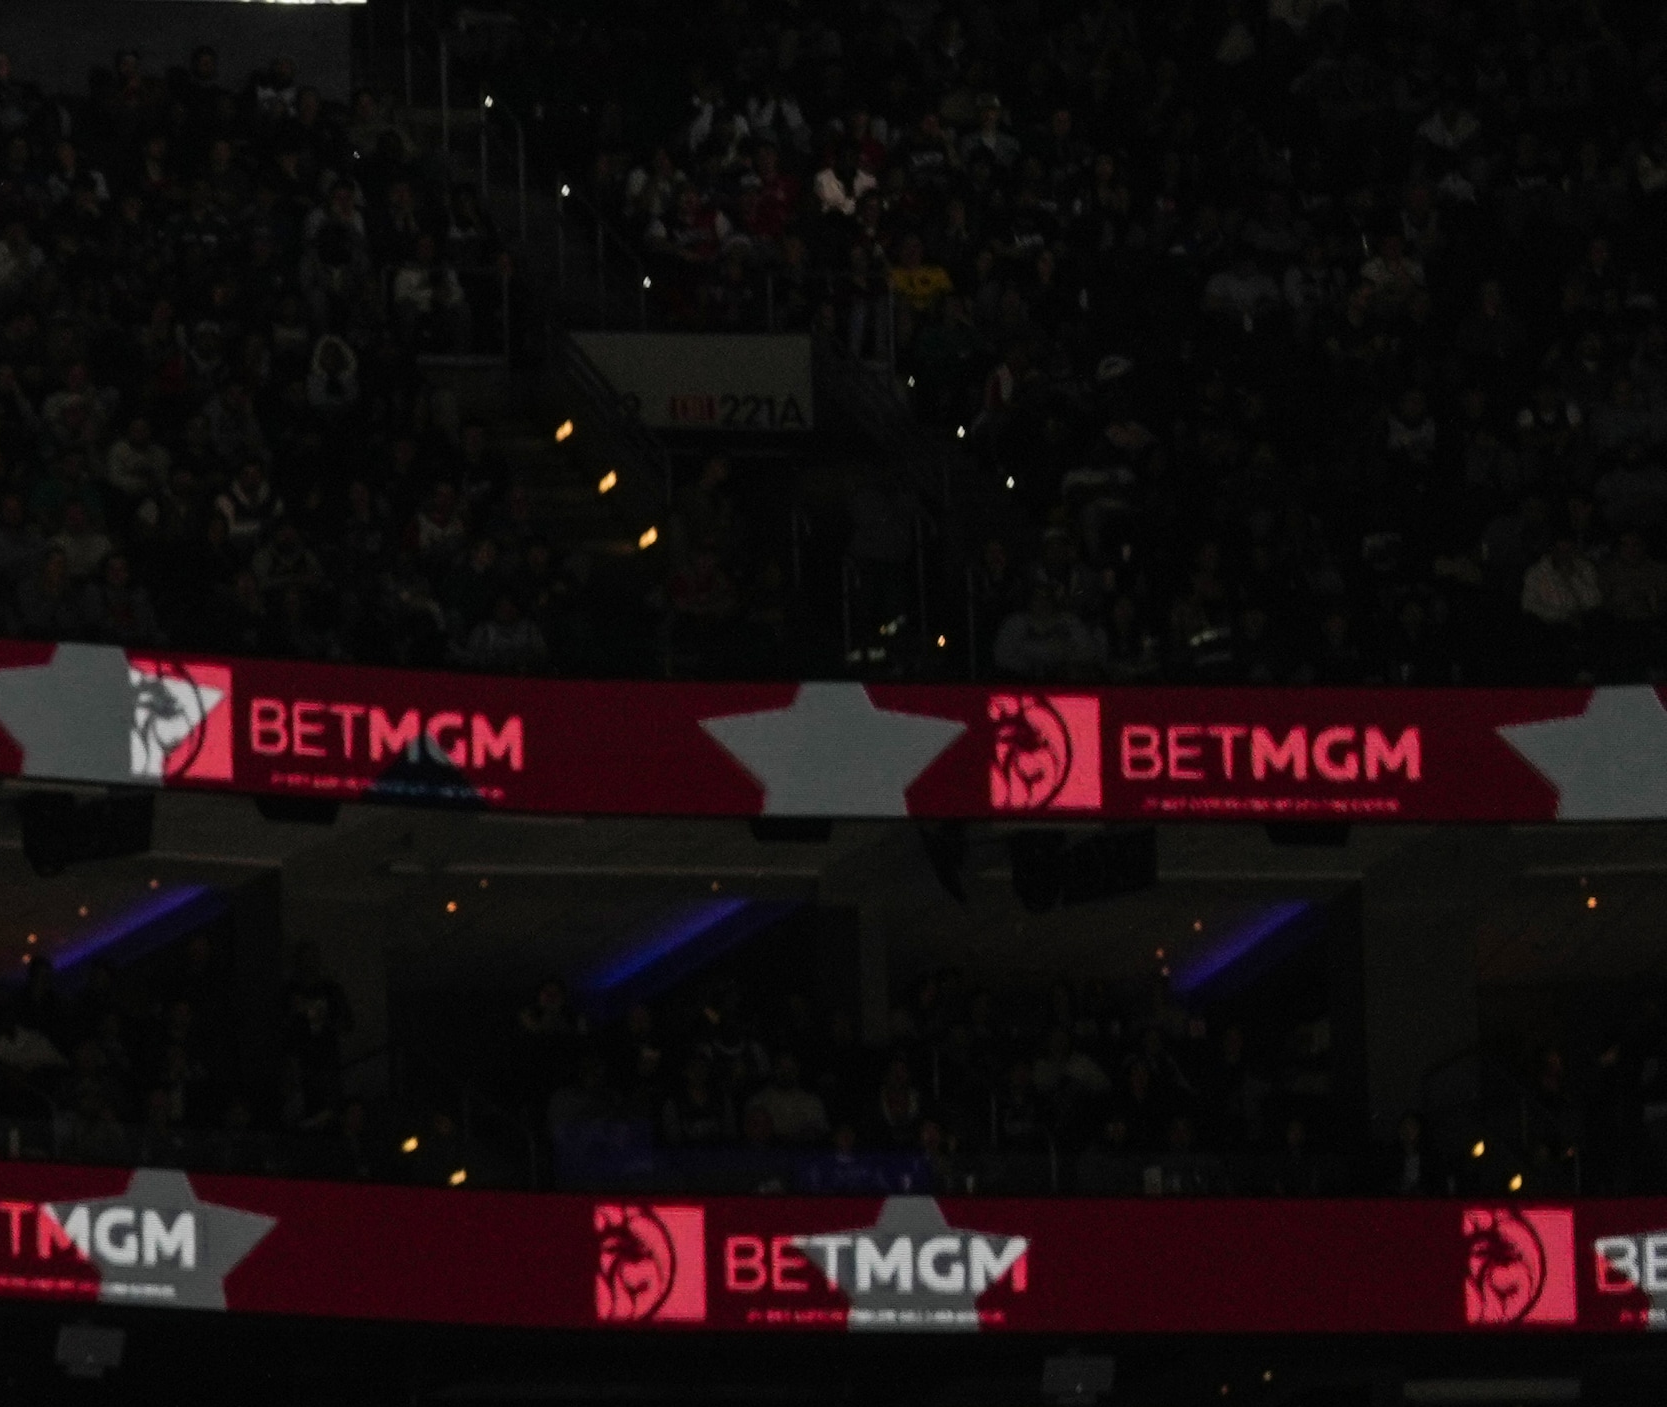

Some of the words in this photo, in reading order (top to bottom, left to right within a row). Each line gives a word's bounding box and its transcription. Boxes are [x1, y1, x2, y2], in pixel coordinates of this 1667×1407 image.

[250, 697, 524, 772] BETMGM
[1119, 724, 1422, 781] BETMGM
[724, 1234, 1028, 1294] BETMGM
